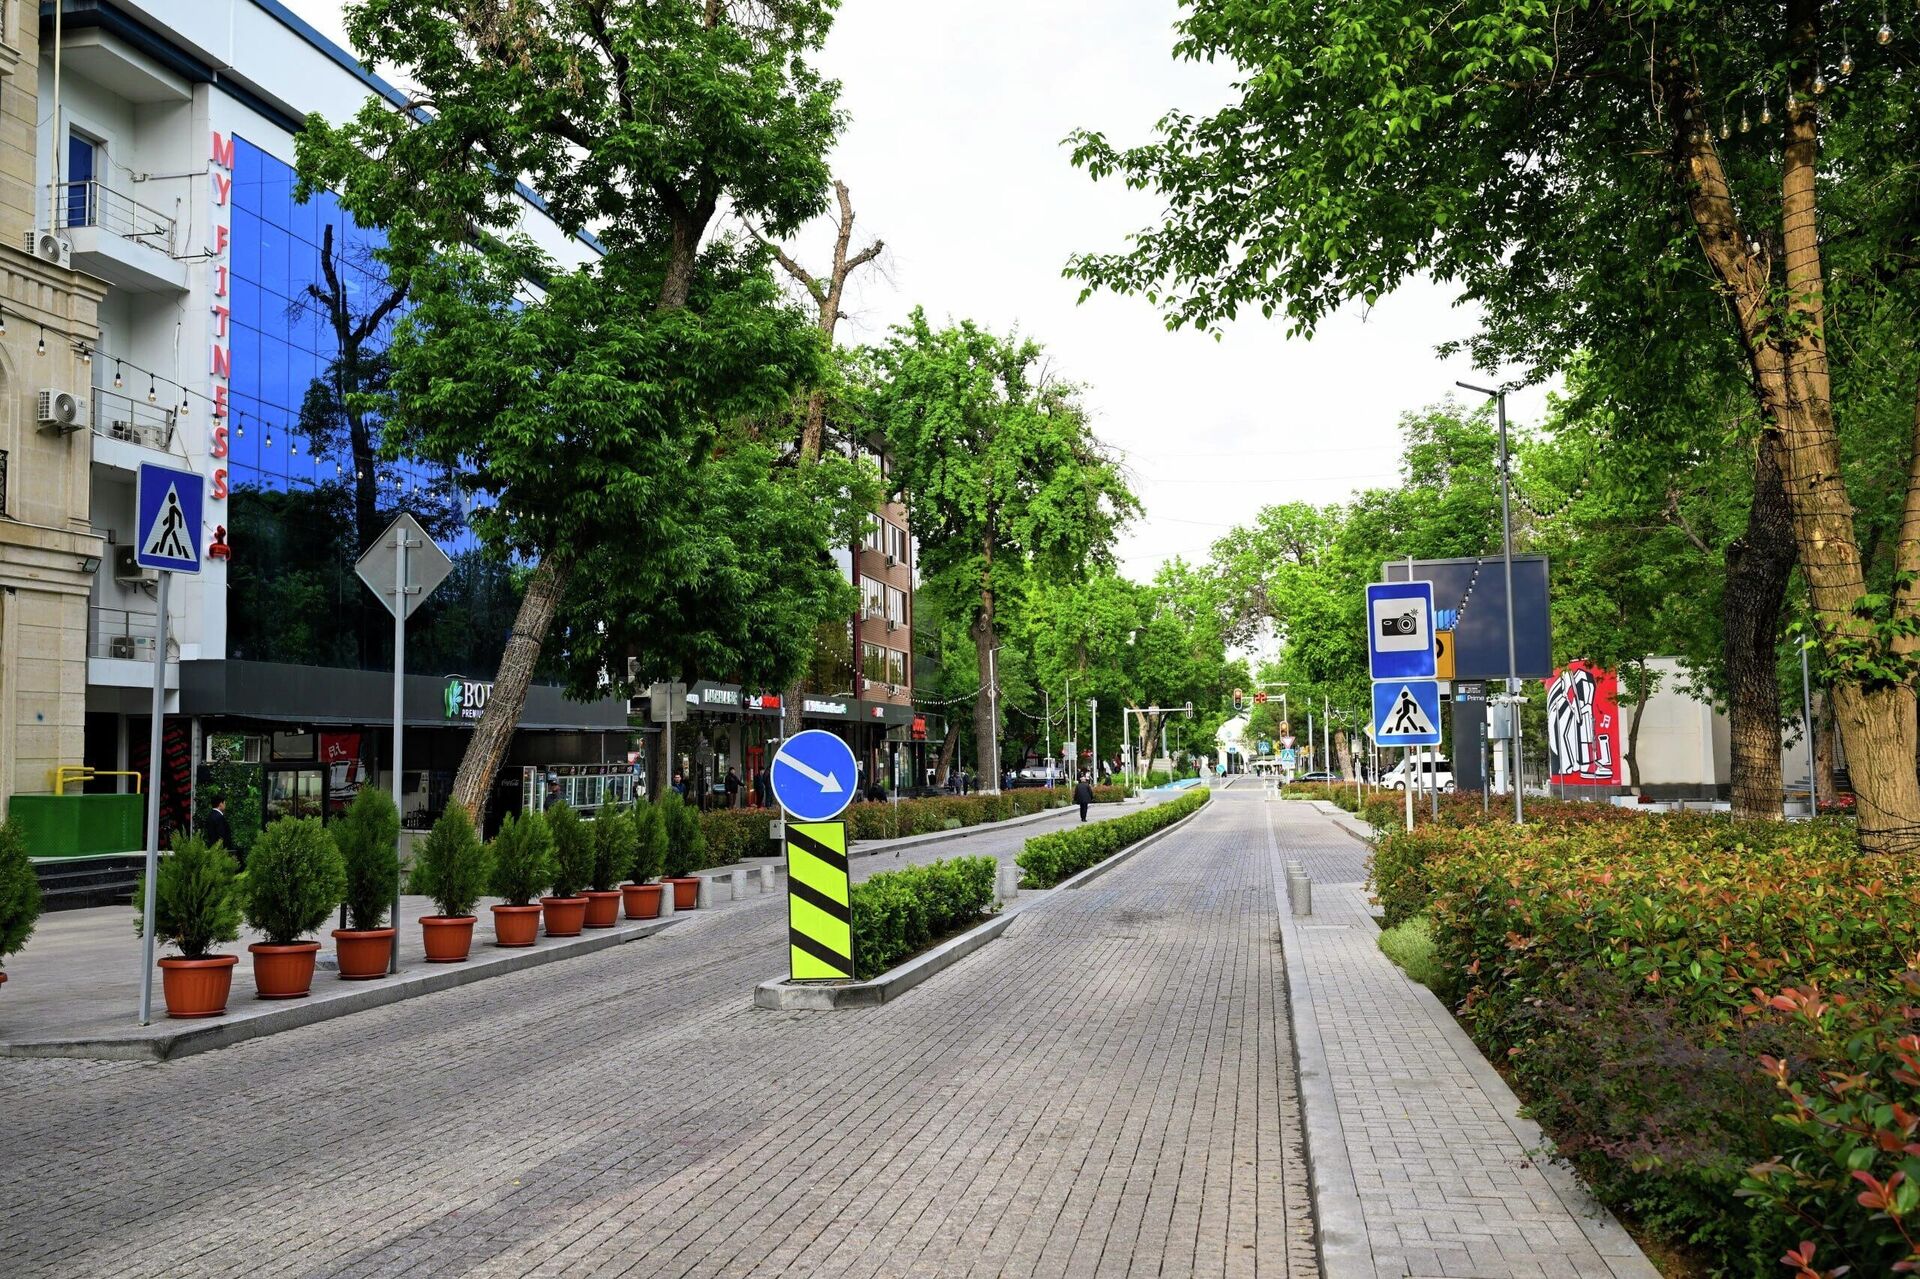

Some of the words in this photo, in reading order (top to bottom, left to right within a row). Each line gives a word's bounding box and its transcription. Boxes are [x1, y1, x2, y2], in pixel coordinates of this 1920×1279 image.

[211, 131, 234, 206] MY
[210, 225, 231, 499] FITNESS
[461, 708, 484, 718] PREMIU
[1466, 694, 1485, 702] Prime
